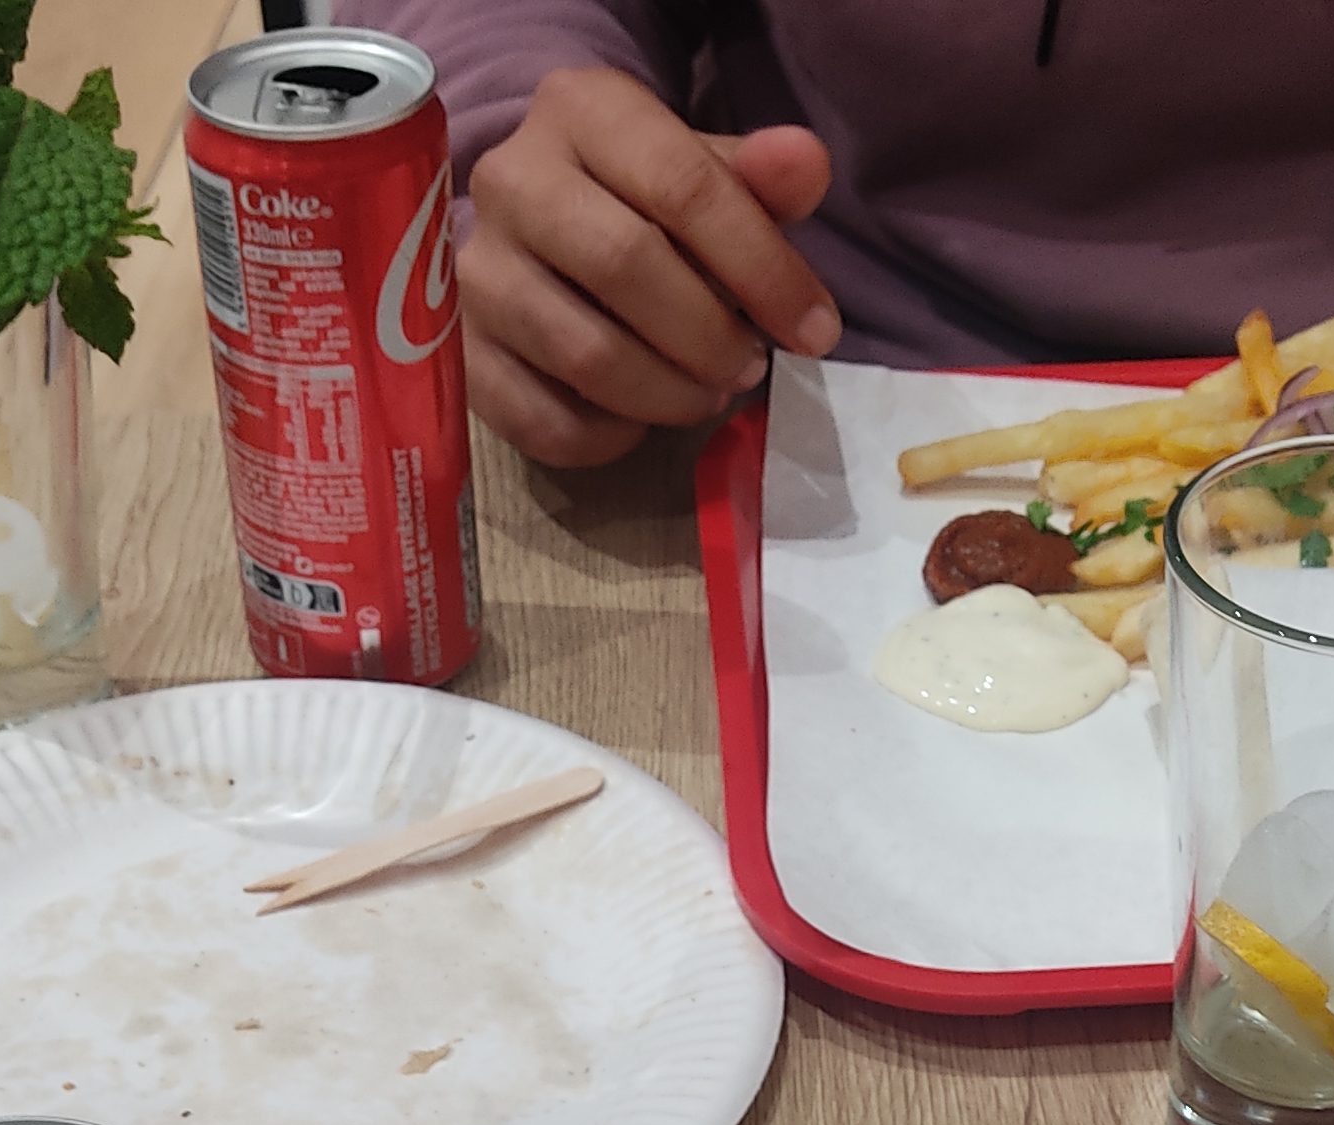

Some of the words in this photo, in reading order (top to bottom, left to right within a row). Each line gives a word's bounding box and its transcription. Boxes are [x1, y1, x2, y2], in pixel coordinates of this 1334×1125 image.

[239, 183, 320, 220] Coke
[405, 575, 426, 676] EMBALLAGE
[419, 553, 441, 670] RECYCLABLE
